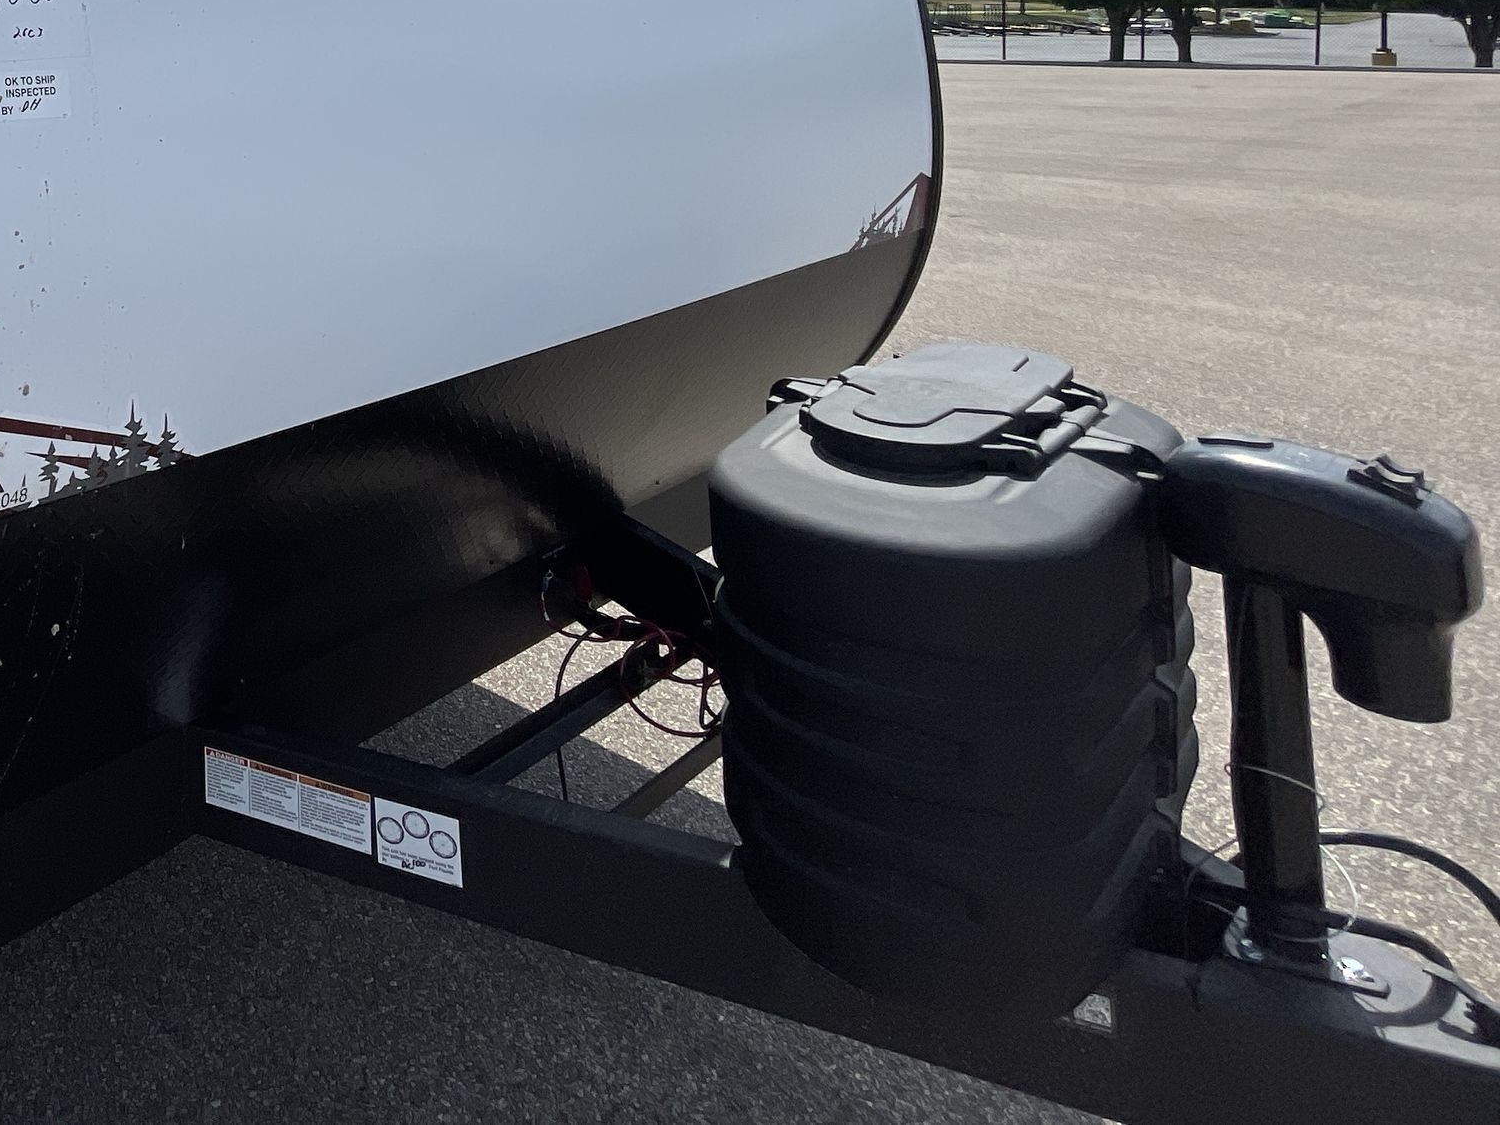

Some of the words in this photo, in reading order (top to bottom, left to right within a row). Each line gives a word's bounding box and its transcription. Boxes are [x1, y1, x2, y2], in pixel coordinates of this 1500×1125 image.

[4, 77, 19, 86] OK
[20, 76, 33, 85] TO
[35, 74, 56, 84] SHIP
[5, 86, 56, 98] INSPECTED
[1, 106, 14, 115] BY
